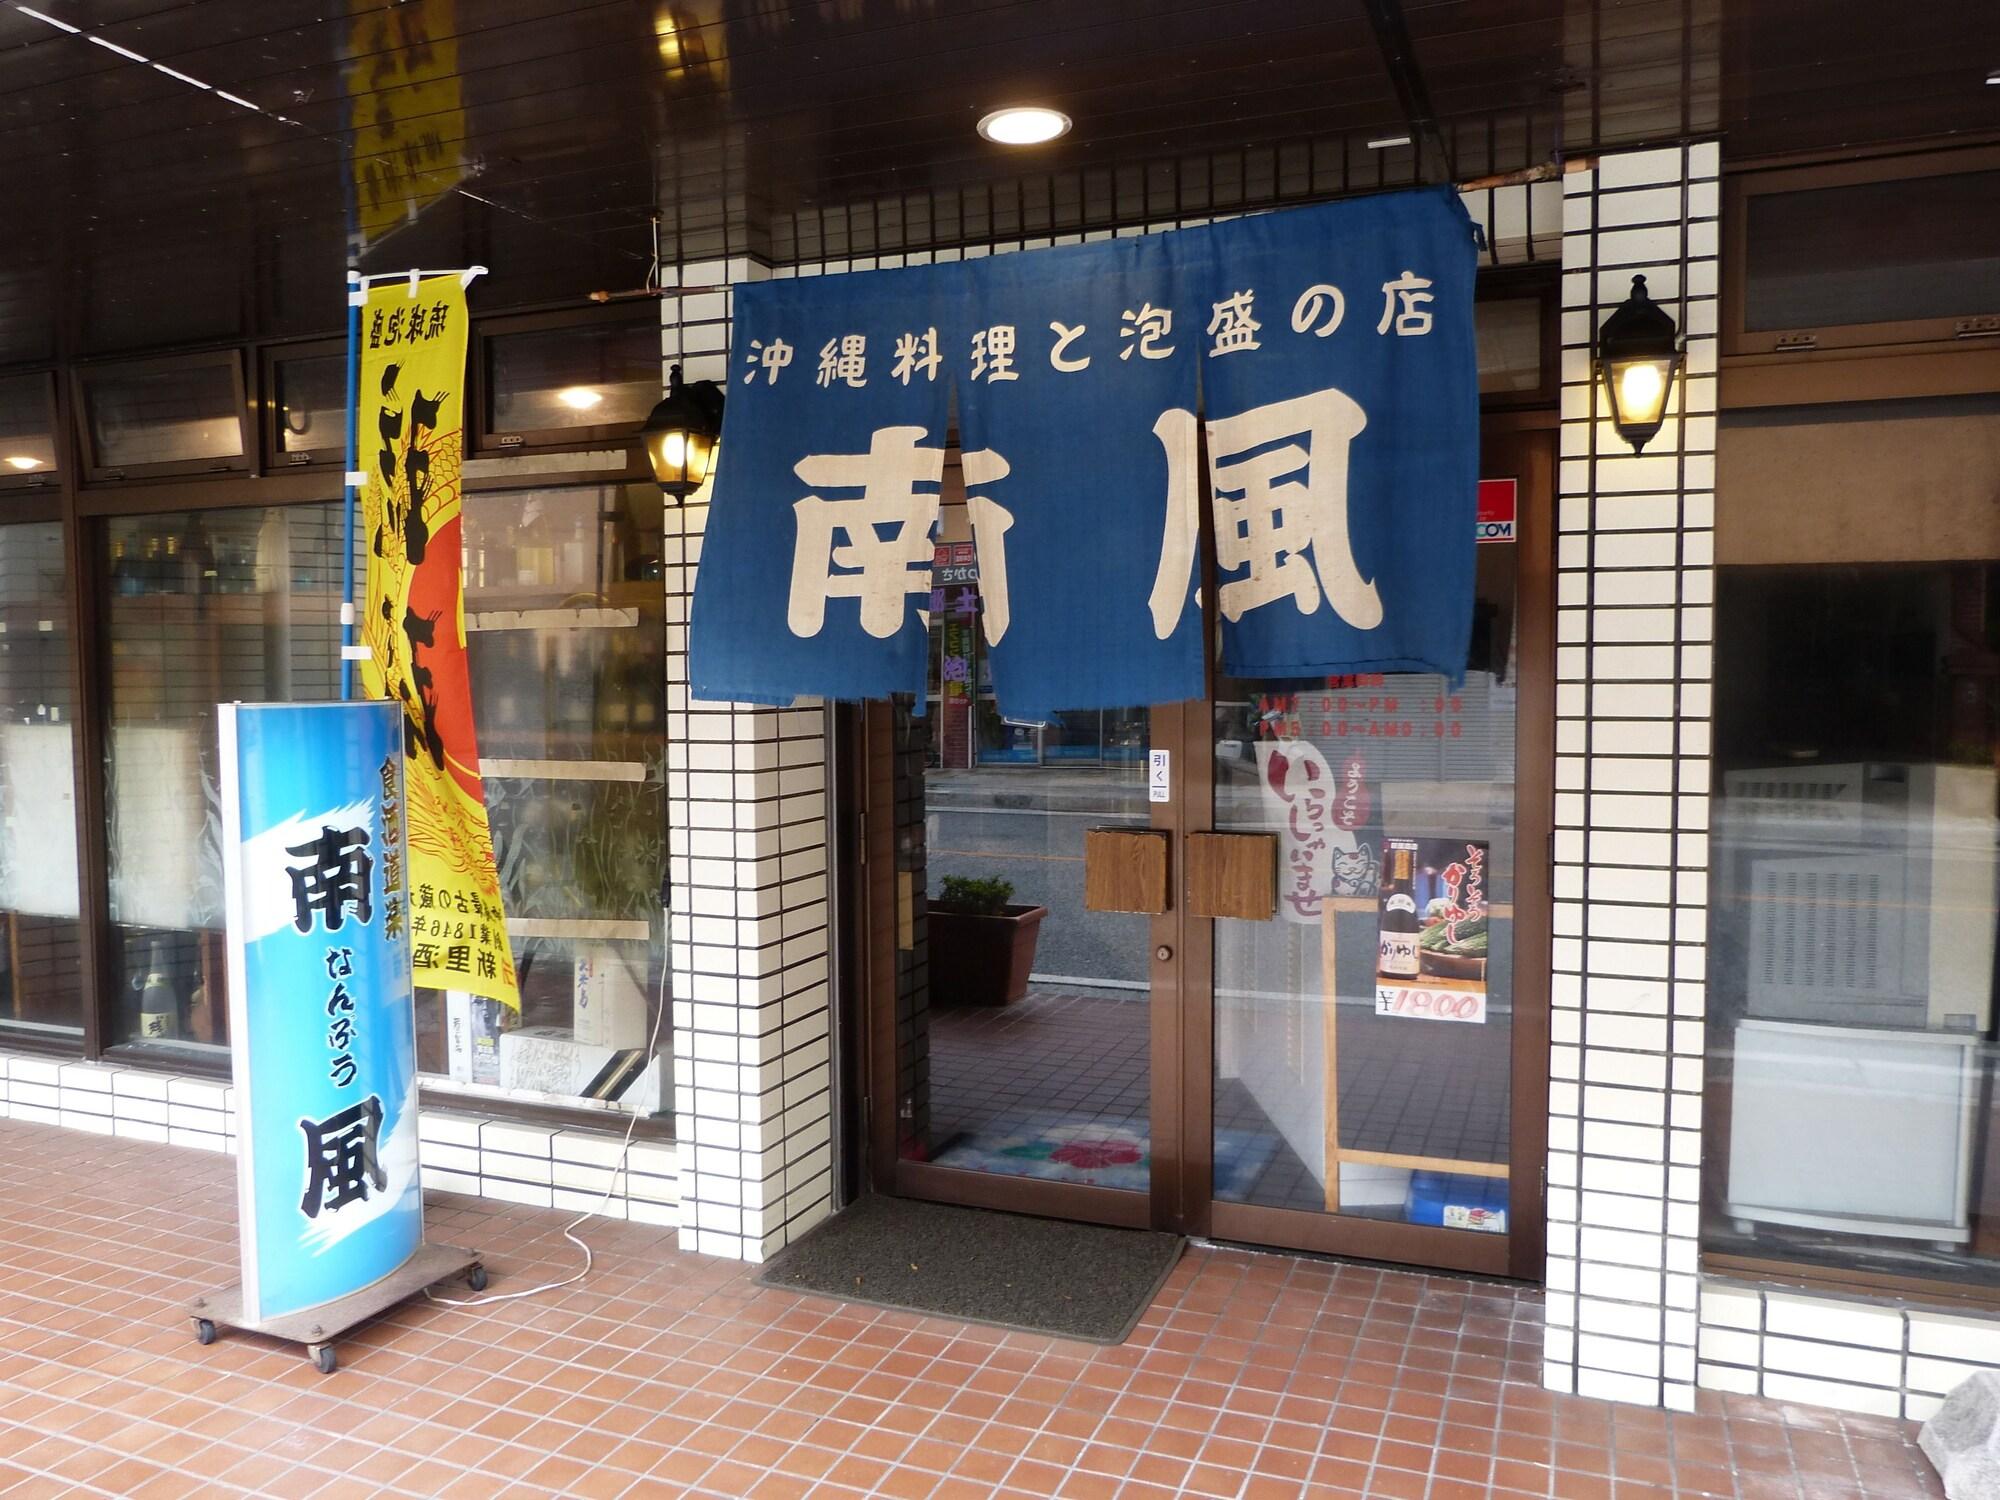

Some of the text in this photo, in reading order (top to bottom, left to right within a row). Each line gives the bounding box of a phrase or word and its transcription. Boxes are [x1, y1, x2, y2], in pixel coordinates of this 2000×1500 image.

[744, 271, 1435, 389] 沖縄料理と泡盛の店
[787, 388, 1385, 648] 南風
[1153, 754, 1166, 782] 引く
[1342, 762, 1361, 826] ようこそ
[285, 824, 375, 934] 南
[1267, 750, 1327, 918] いらっしゃいませ
[299, 1095, 388, 1219] 風
